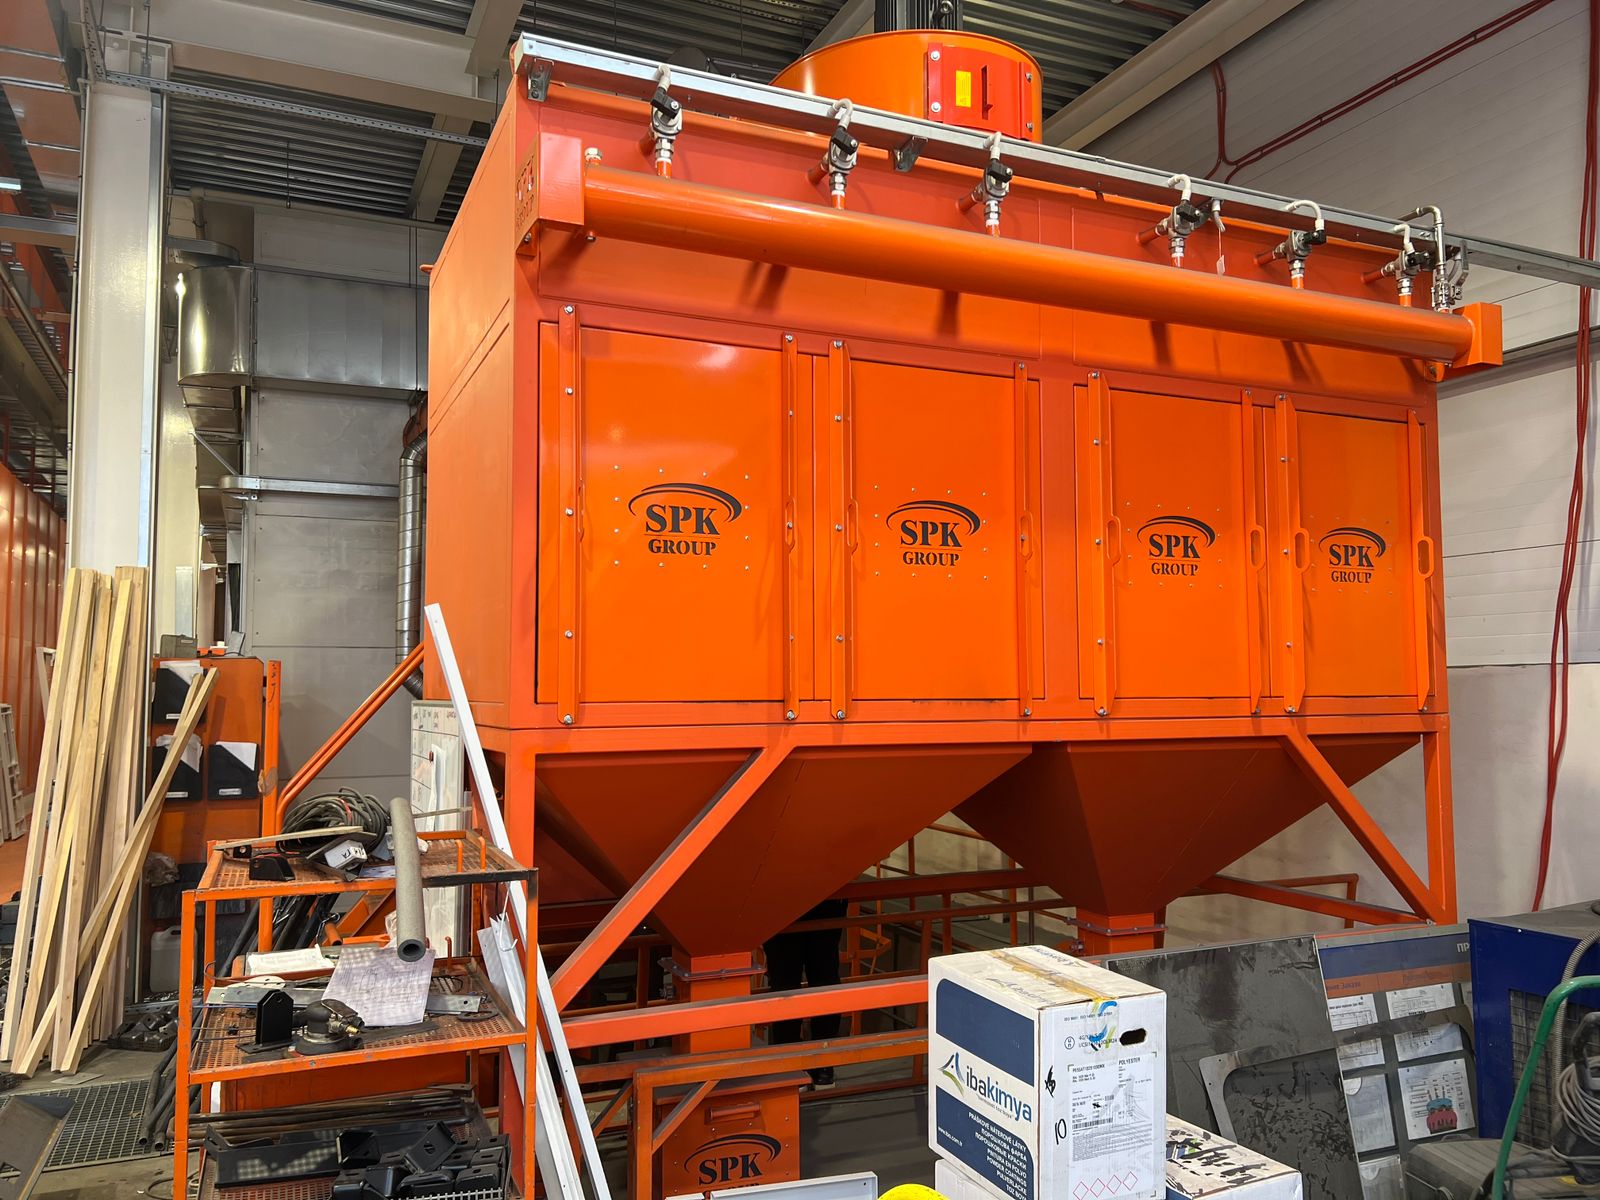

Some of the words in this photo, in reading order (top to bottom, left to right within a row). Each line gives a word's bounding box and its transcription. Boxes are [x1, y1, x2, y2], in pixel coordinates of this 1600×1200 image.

[645, 504, 720, 535] SPK
[900, 519, 963, 548] SPK
[1148, 533, 1200, 559] SPK
[647, 538, 717, 556] GROUP
[902, 550, 960, 567] GROUP
[1328, 543, 1374, 568] SPK
[1150, 562, 1199, 576] GROUP
[1330, 570, 1372, 584] GROUP
[966, 1065, 1032, 1122] ibakimya
[1054, 1118, 1067, 1145] 10
[698, 1152, 763, 1186] SPK
[986, 1155, 1005, 1172] POWDER
